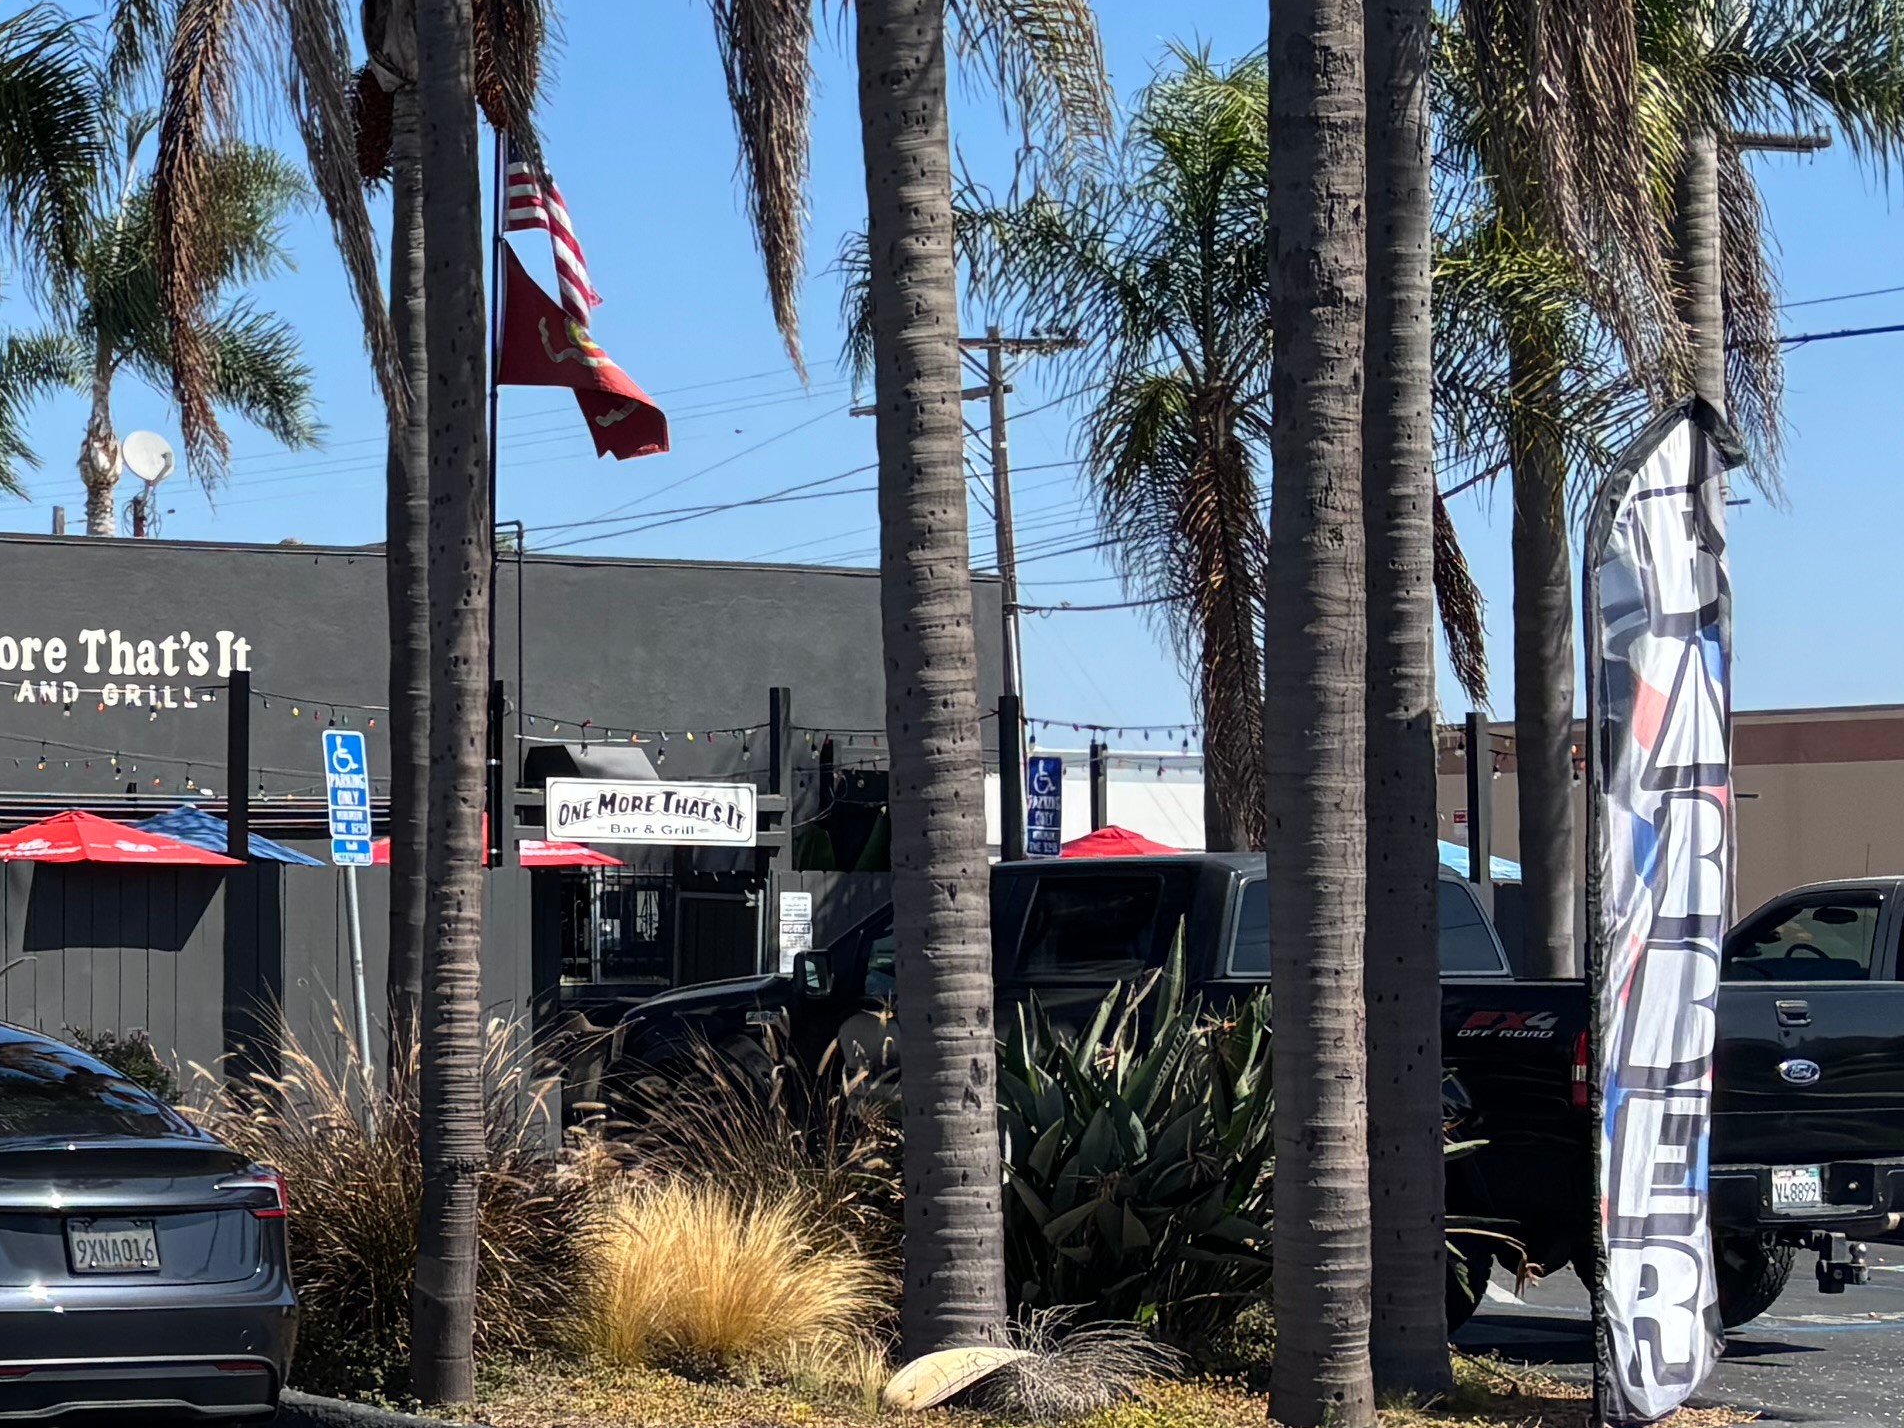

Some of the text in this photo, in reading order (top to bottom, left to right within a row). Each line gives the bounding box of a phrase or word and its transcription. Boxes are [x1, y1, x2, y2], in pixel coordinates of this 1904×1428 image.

[78, 629, 210, 678] That's
[215, 630, 251, 677] It
[16, 680, 79, 705] AND
[558, 799, 593, 826] ONE
[597, 790, 656, 816] MORE
[725, 801, 746, 831] IT
[610, 823, 694, 835] Bar & Grill
[1457, 1029, 1493, 1037] OFF
[76, 1238, 155, 1264] 9XNA016
